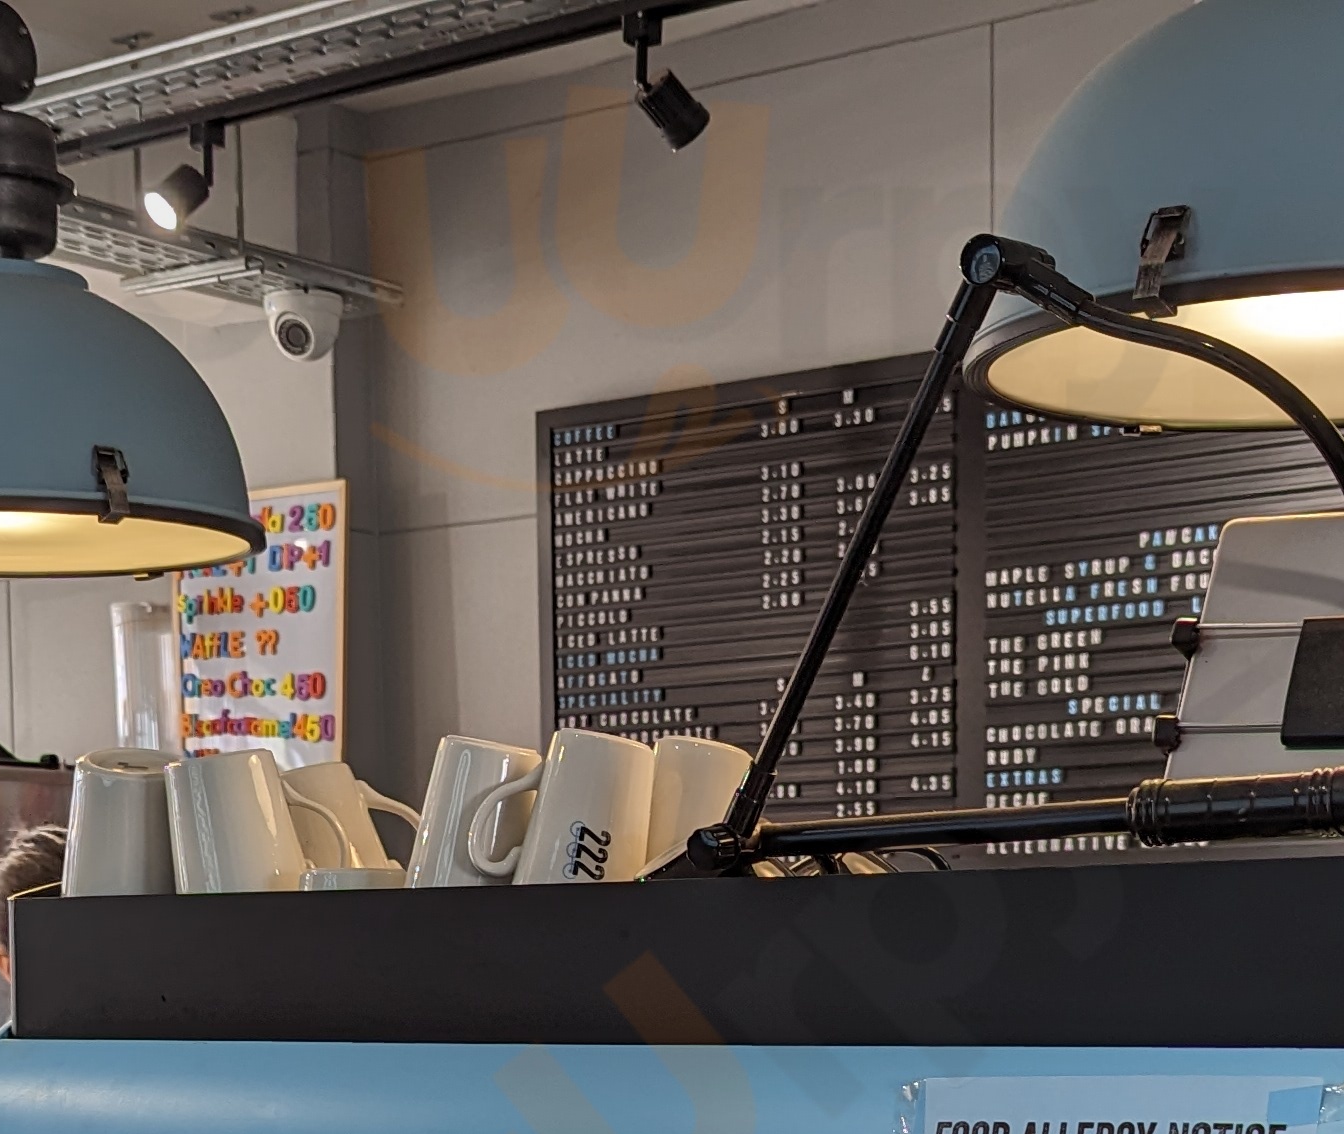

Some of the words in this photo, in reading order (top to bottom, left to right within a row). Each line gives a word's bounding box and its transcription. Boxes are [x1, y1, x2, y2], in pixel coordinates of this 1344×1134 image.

[554, 425, 616, 446] COFFEE
[988, 424, 1078, 450] PUMPKIN
[986, 565, 1050, 587] MAPLE
[1064, 556, 1130, 580] SYRUP
[986, 585, 1076, 609] NUTELLA
[1090, 577, 1158, 599] FRESH
[1046, 599, 1164, 626] SUPERFOOD
[989, 636, 1025, 655] THE
[1037, 628, 1103, 651] GREEN
[988, 659, 1024, 676] THE
[1037, 652, 1090, 673] PINK
[988, 681, 1024, 699] THE
[1037, 675, 1089, 696] GOLD
[1067, 692, 1161, 715] SPECIAL
[986, 720, 1102, 743] CHOCOLATE
[987, 747, 1037, 766] RUBY
[986, 768, 1063, 788] EXTRAS
[572, 826, 612, 881] 222
